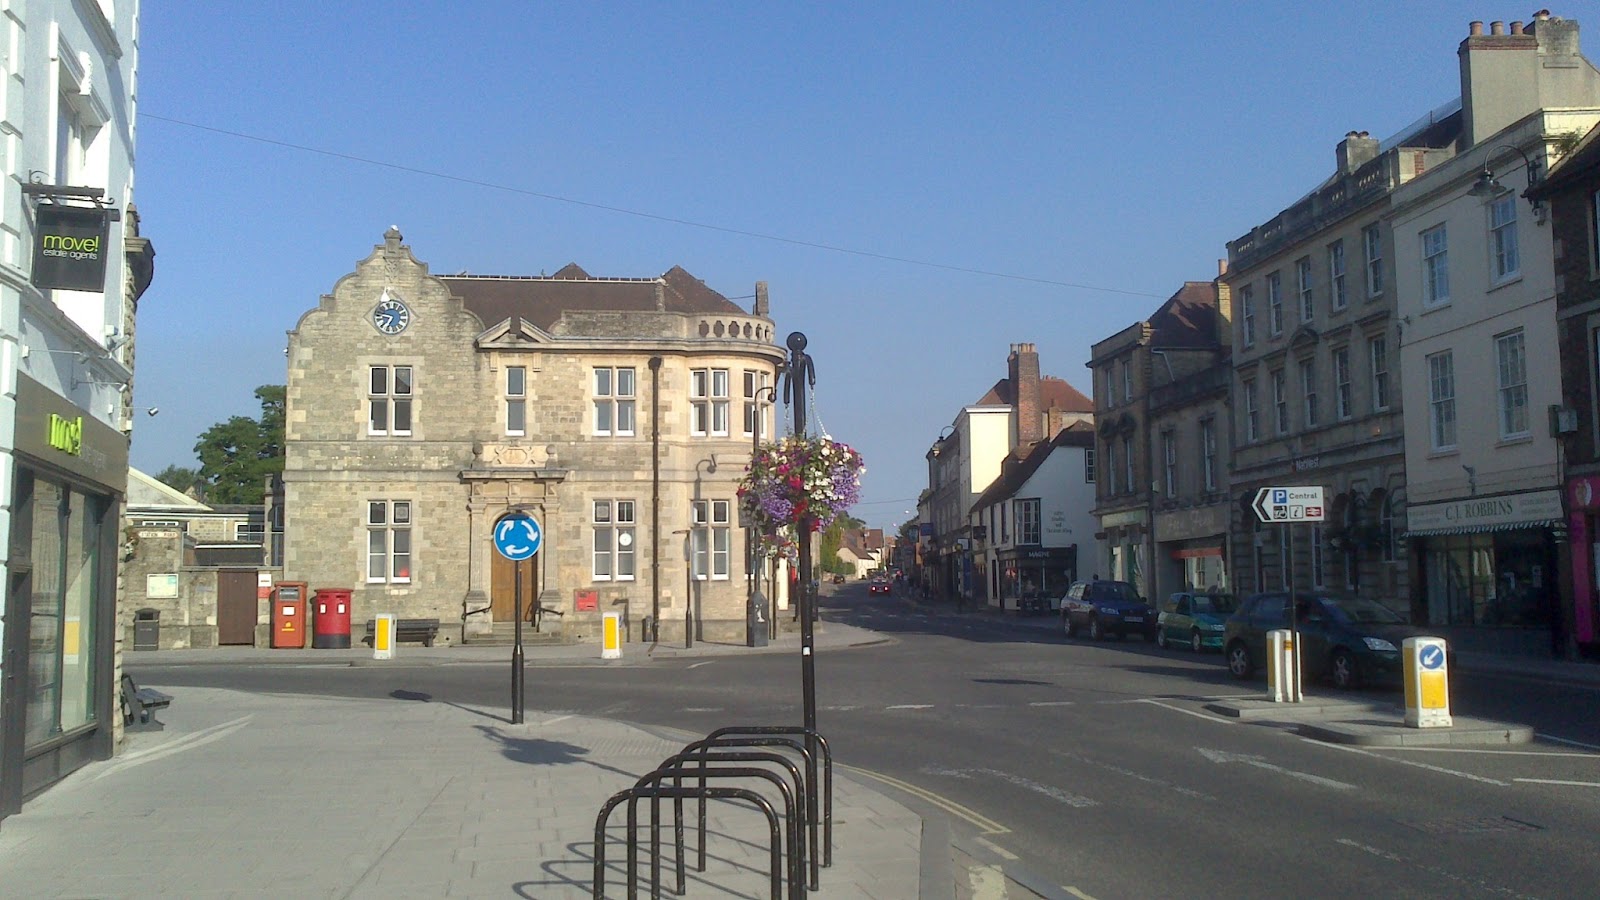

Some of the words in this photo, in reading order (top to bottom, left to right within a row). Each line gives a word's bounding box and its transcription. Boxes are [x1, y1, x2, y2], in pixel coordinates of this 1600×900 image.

[43, 235, 99, 252] move!
[43, 249, 67, 257] estate
[69, 251, 97, 260] agents
[1275, 491, 1285, 503] P
[1289, 492, 1318, 500] Central
[1465, 499, 1513, 518] ROBBINS
